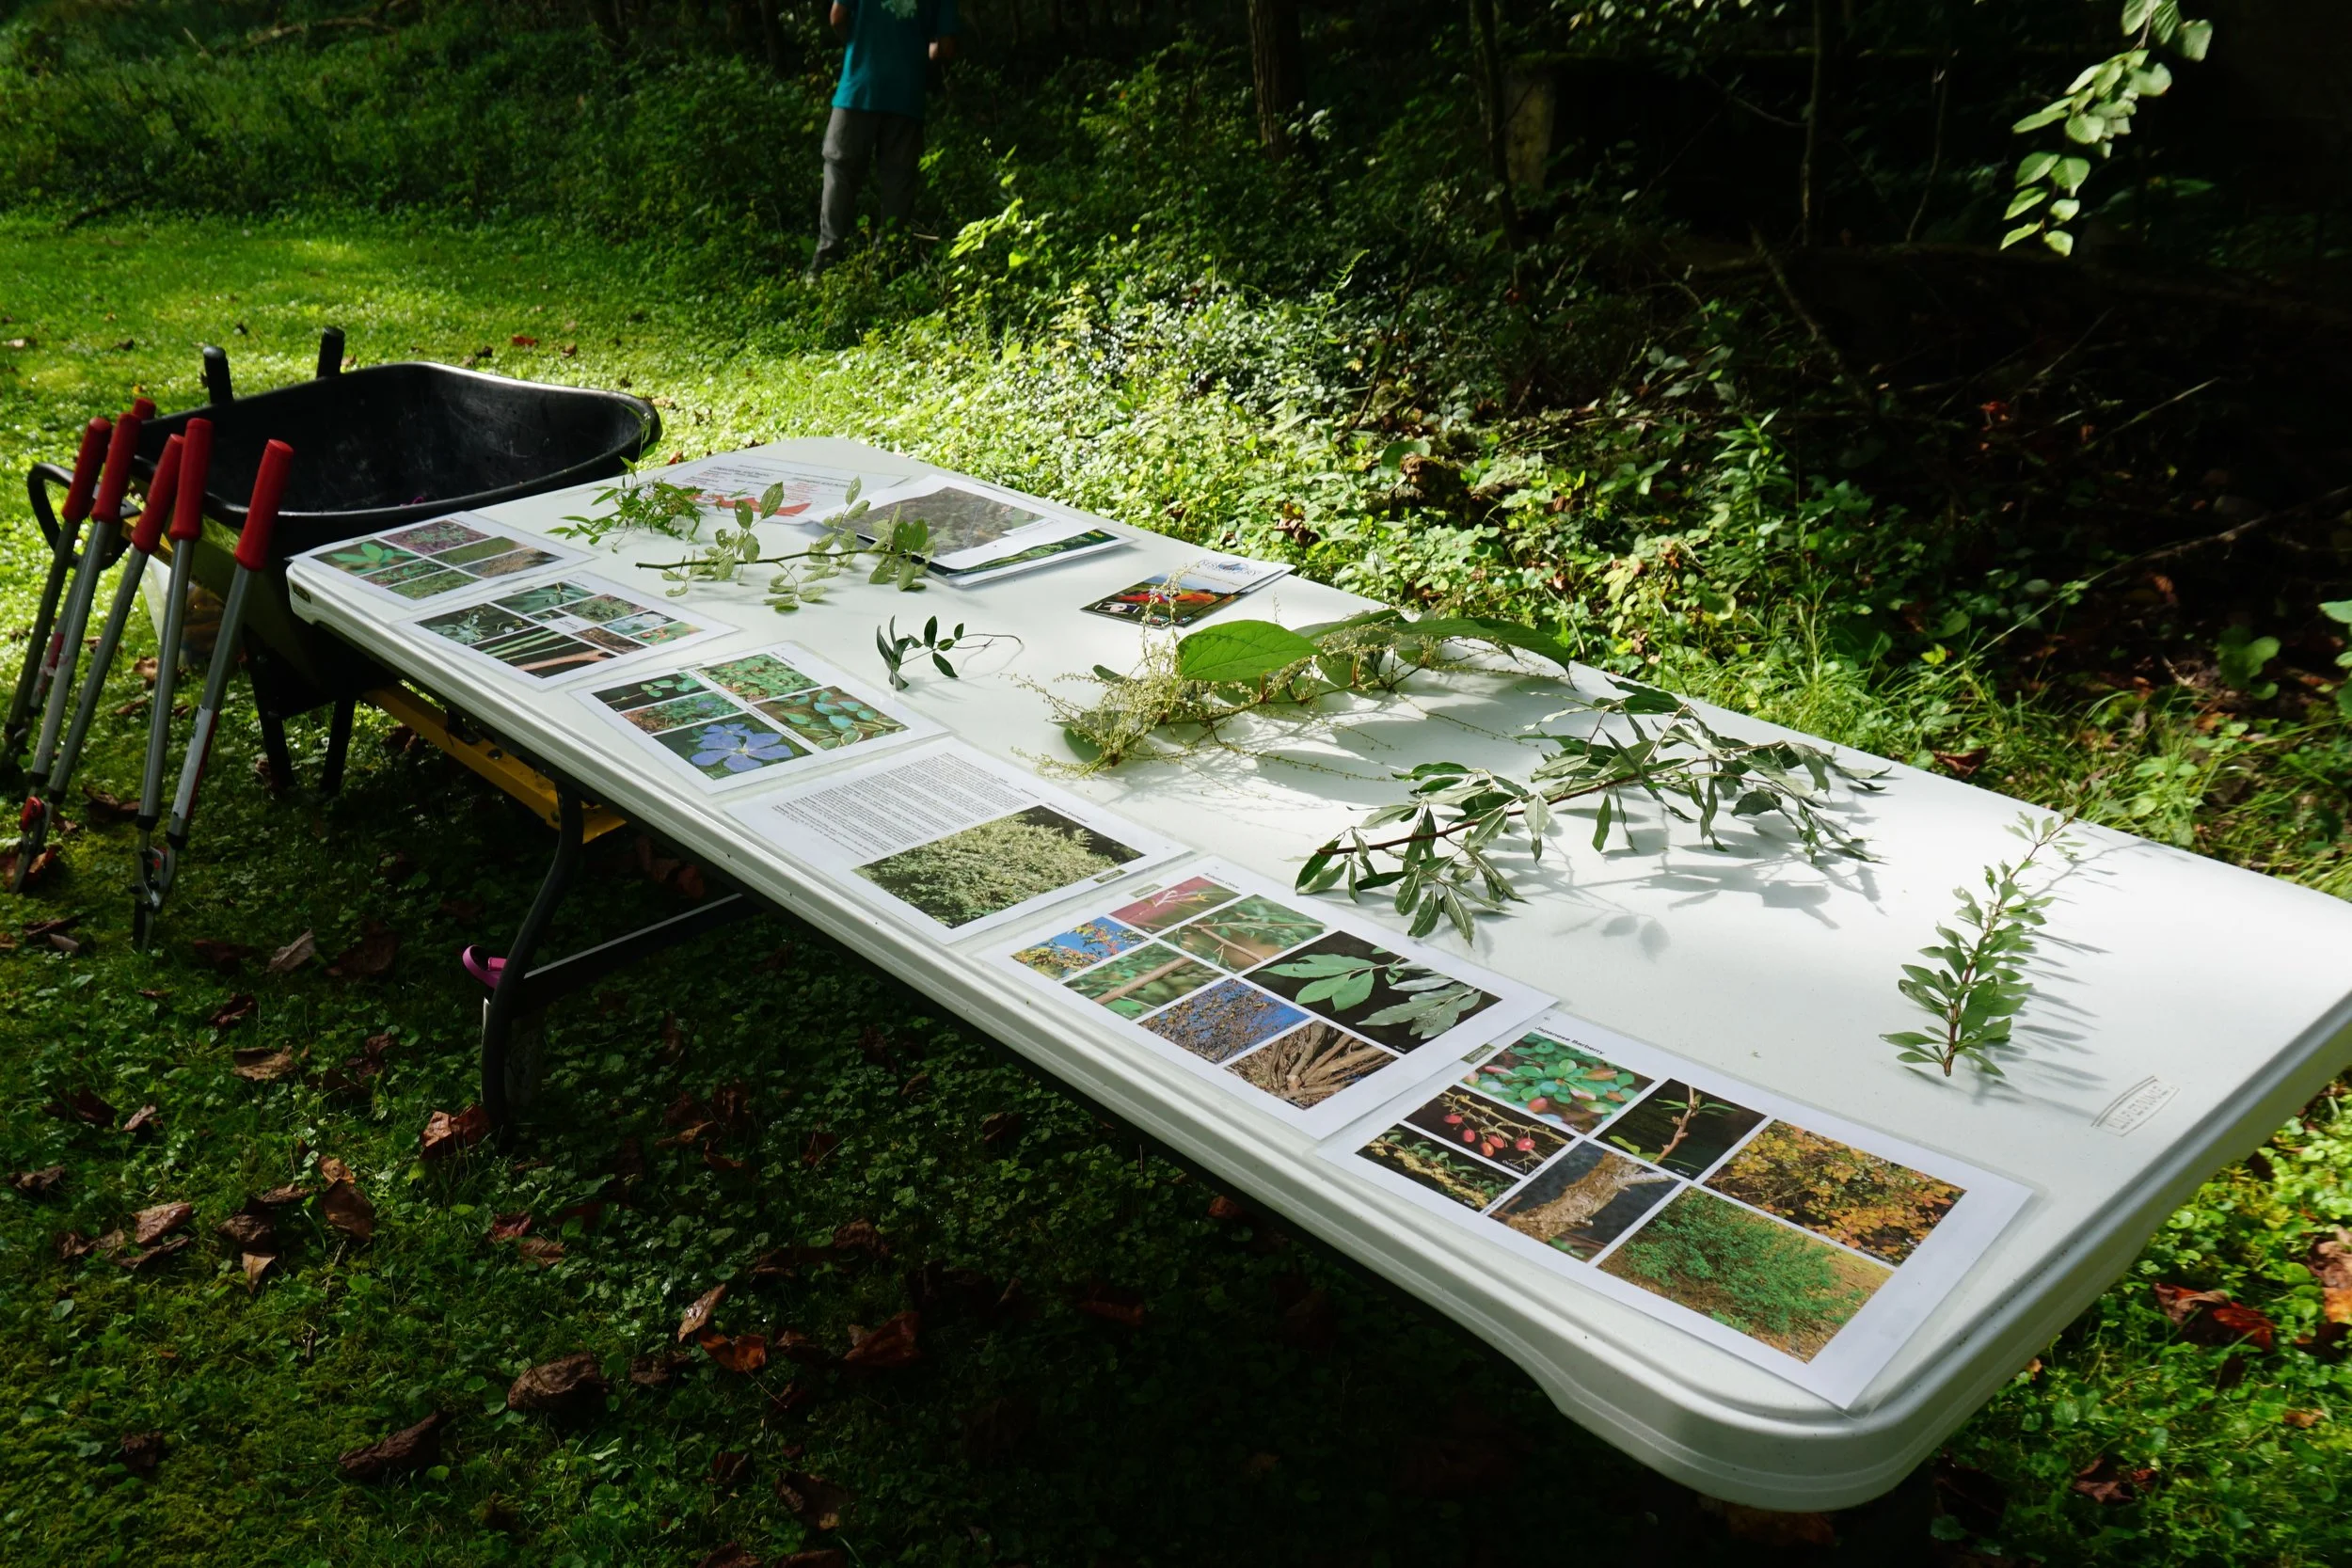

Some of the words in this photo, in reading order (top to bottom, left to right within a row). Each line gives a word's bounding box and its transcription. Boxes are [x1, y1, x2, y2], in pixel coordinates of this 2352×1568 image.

[1534, 1026, 1571, 1042] Japanese
[1571, 1038, 1606, 1055] Barberry
[1502, 1160, 1525, 1172] October
